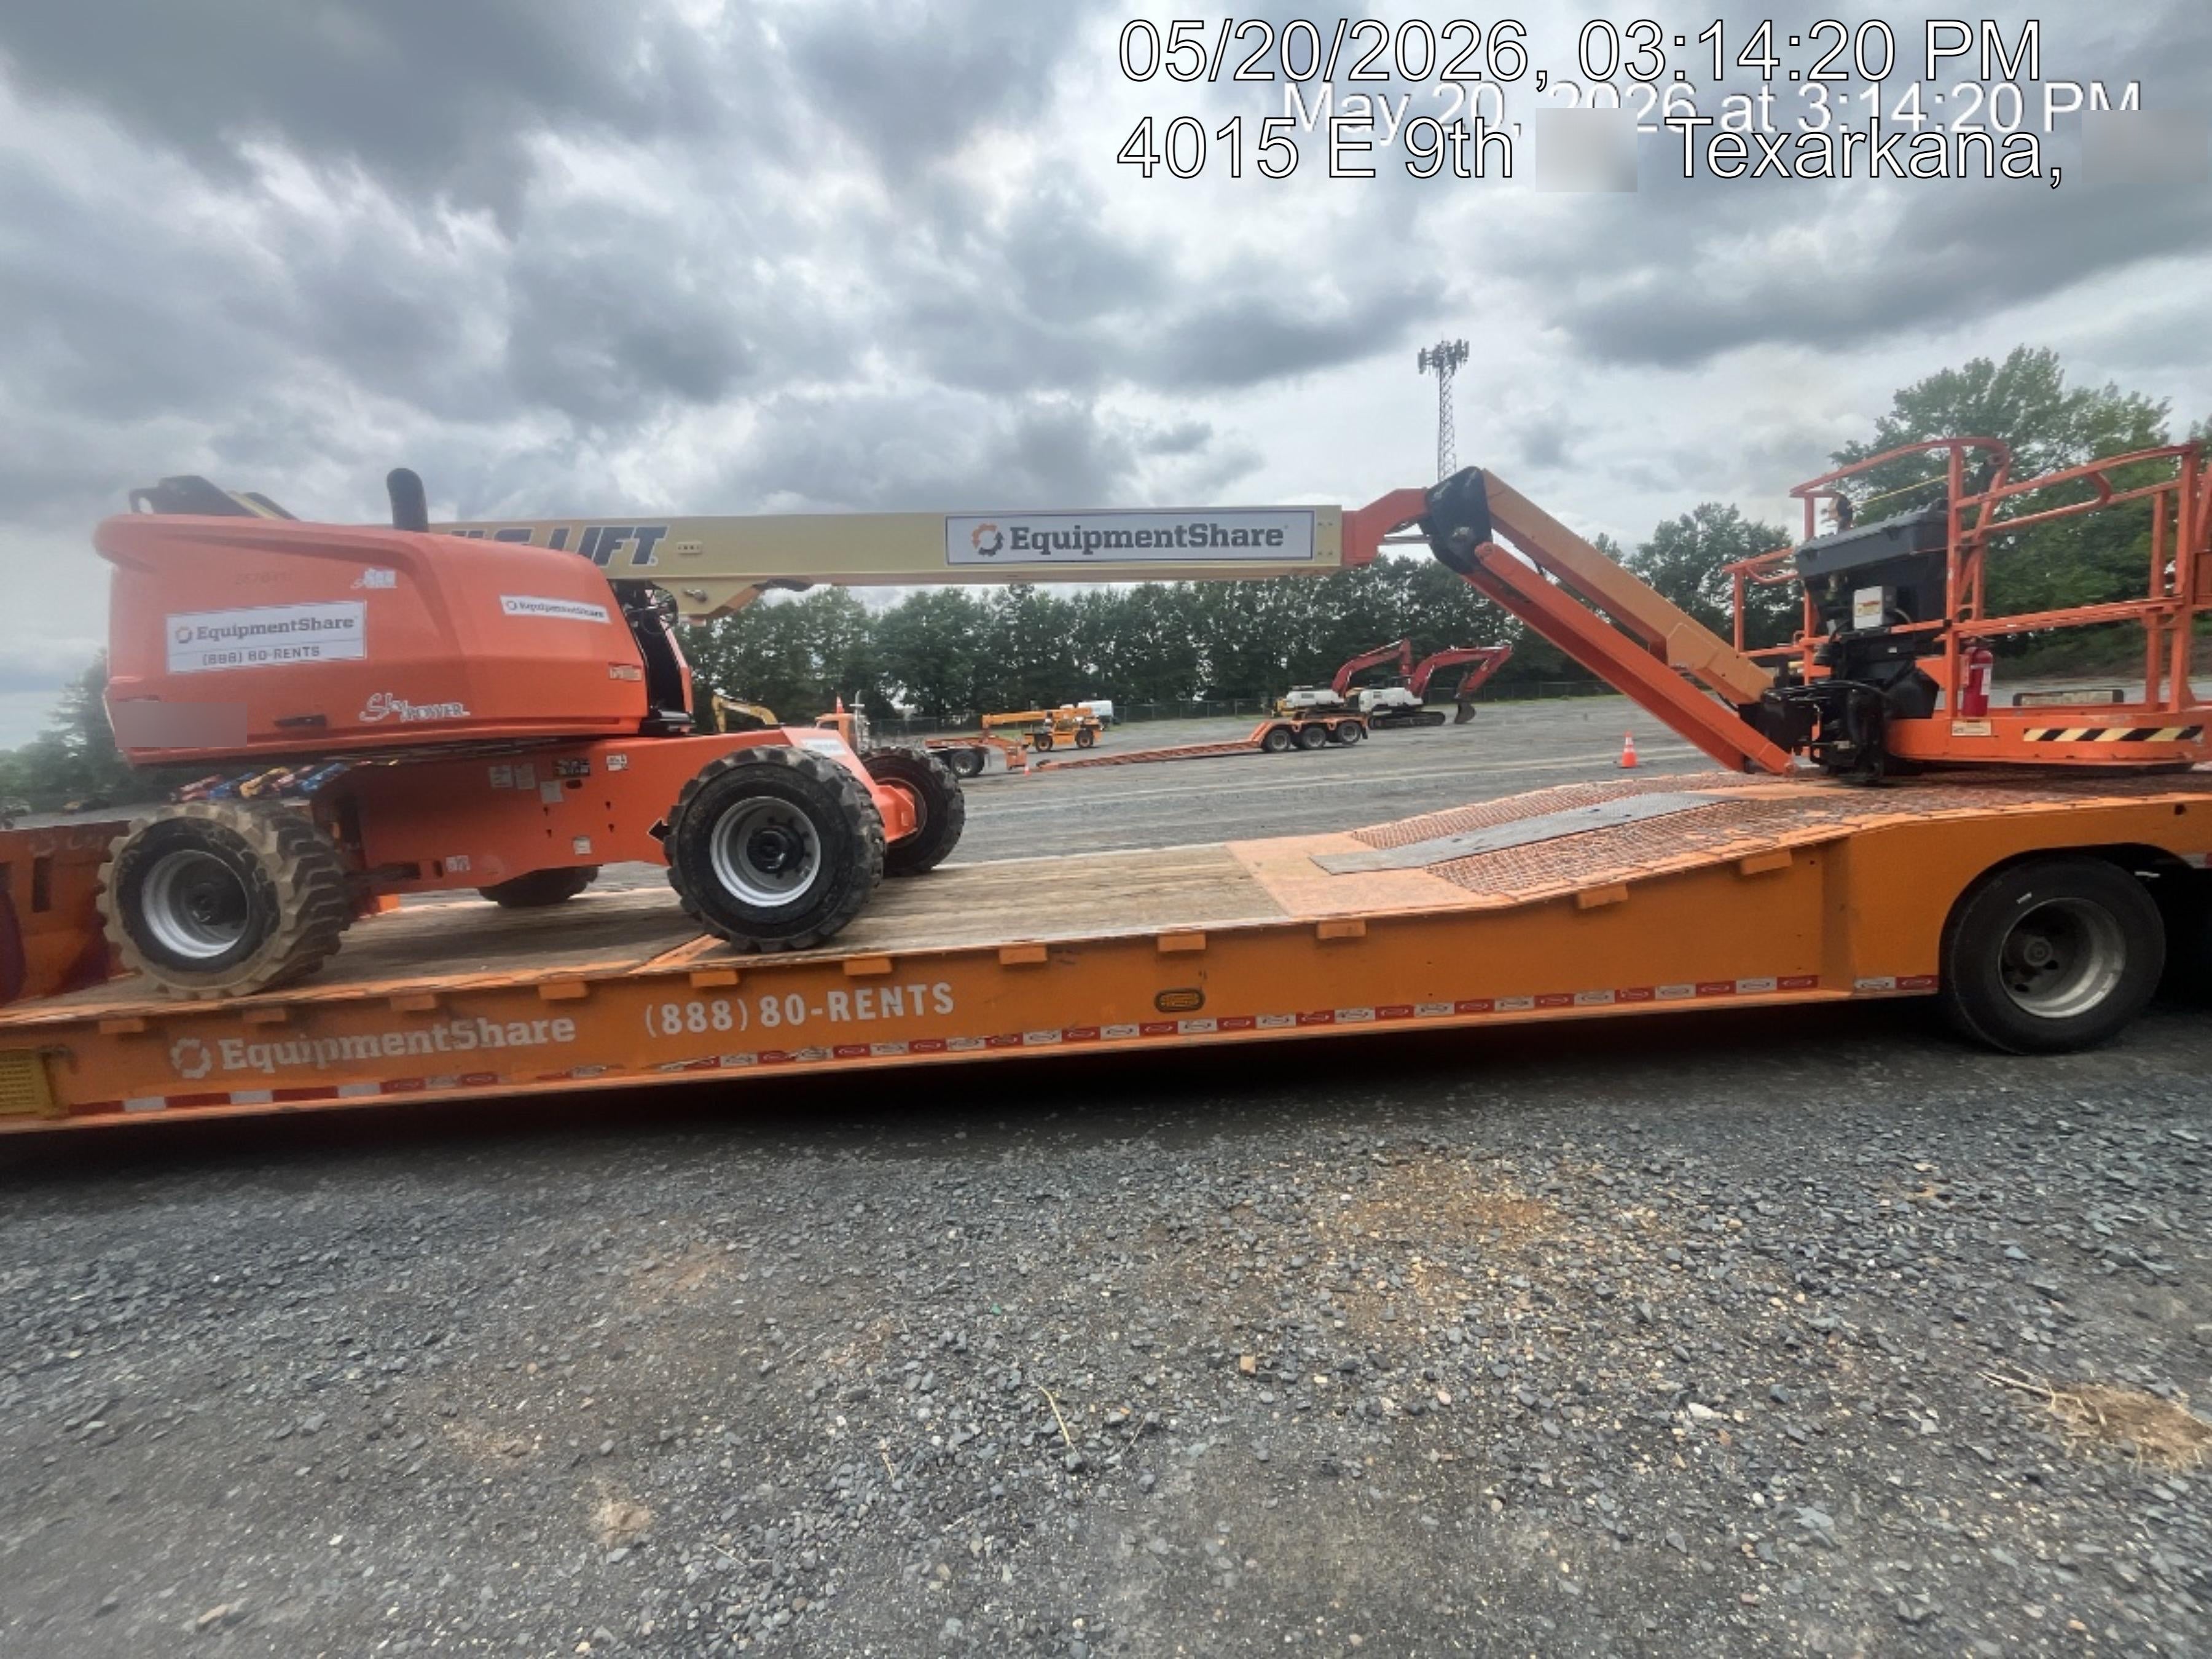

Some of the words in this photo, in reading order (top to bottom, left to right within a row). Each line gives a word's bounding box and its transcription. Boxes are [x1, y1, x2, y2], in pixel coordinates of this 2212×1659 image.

[1010, 522, 1284, 555] EquipmentShare
[196, 618, 354, 642] EquipmentShare
[202, 651, 242, 666] (888)
[248, 646, 320, 662] 80-RENTS
[645, 998, 749, 1038] (888)
[758, 982, 954, 1027] 80-RENTS
[222, 1017, 576, 1073] EquipmentShare
